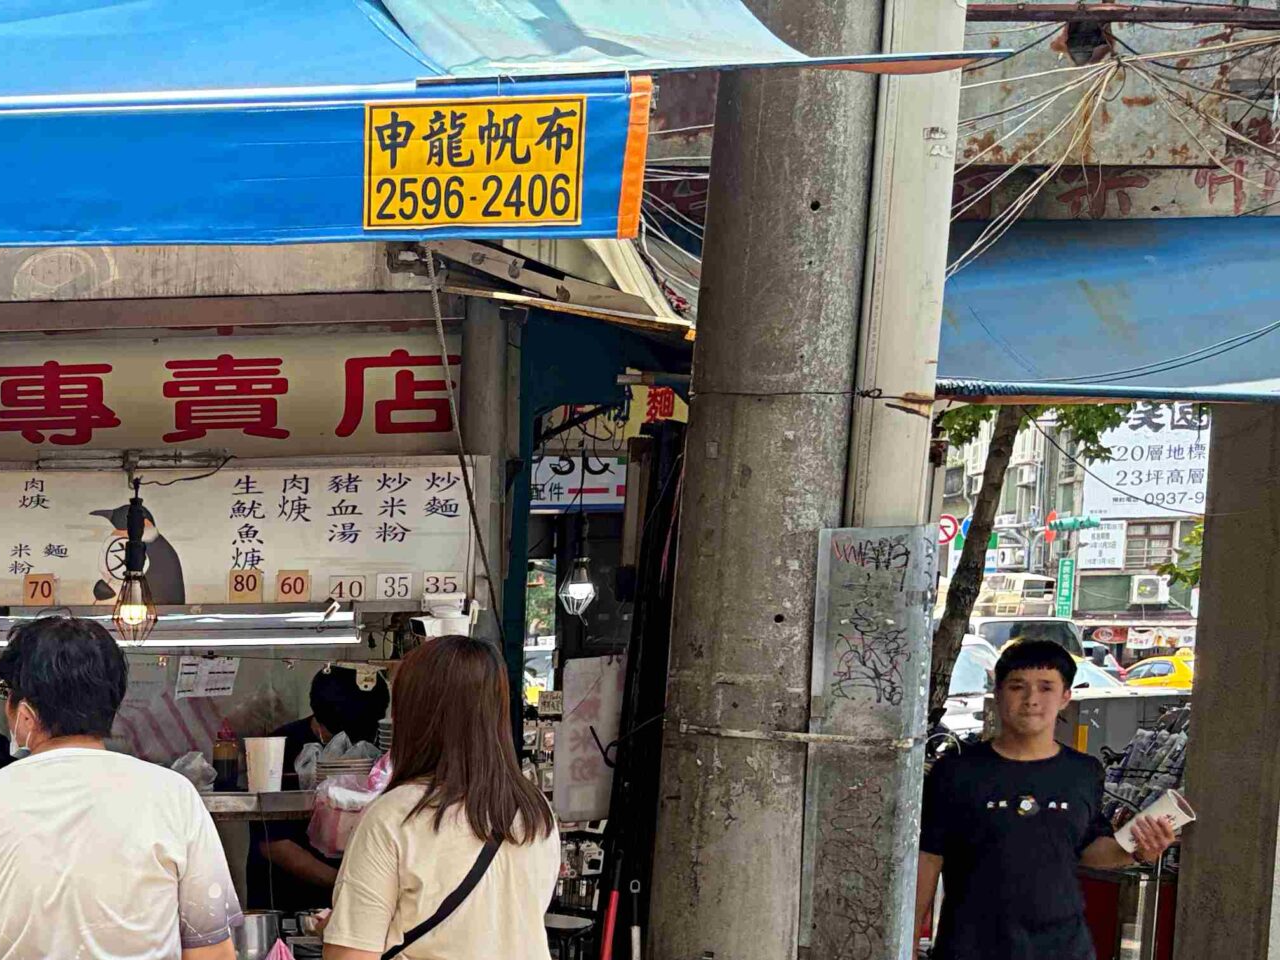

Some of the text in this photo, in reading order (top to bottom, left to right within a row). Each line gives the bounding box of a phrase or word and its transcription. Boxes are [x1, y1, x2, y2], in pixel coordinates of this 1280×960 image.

[374, 107, 579, 170] 申龍帆布
[376, 173, 570, 220] 2596-2406
[424, 471, 460, 518] 炒麵
[375, 472, 412, 543] 炒米粉
[28, 580, 53, 599] 70
[233, 574, 257, 592] 80
[280, 576, 305, 595] 60
[330, 580, 363, 599] 40
[383, 576, 409, 598] 35
[425, 576, 458, 594] 35
